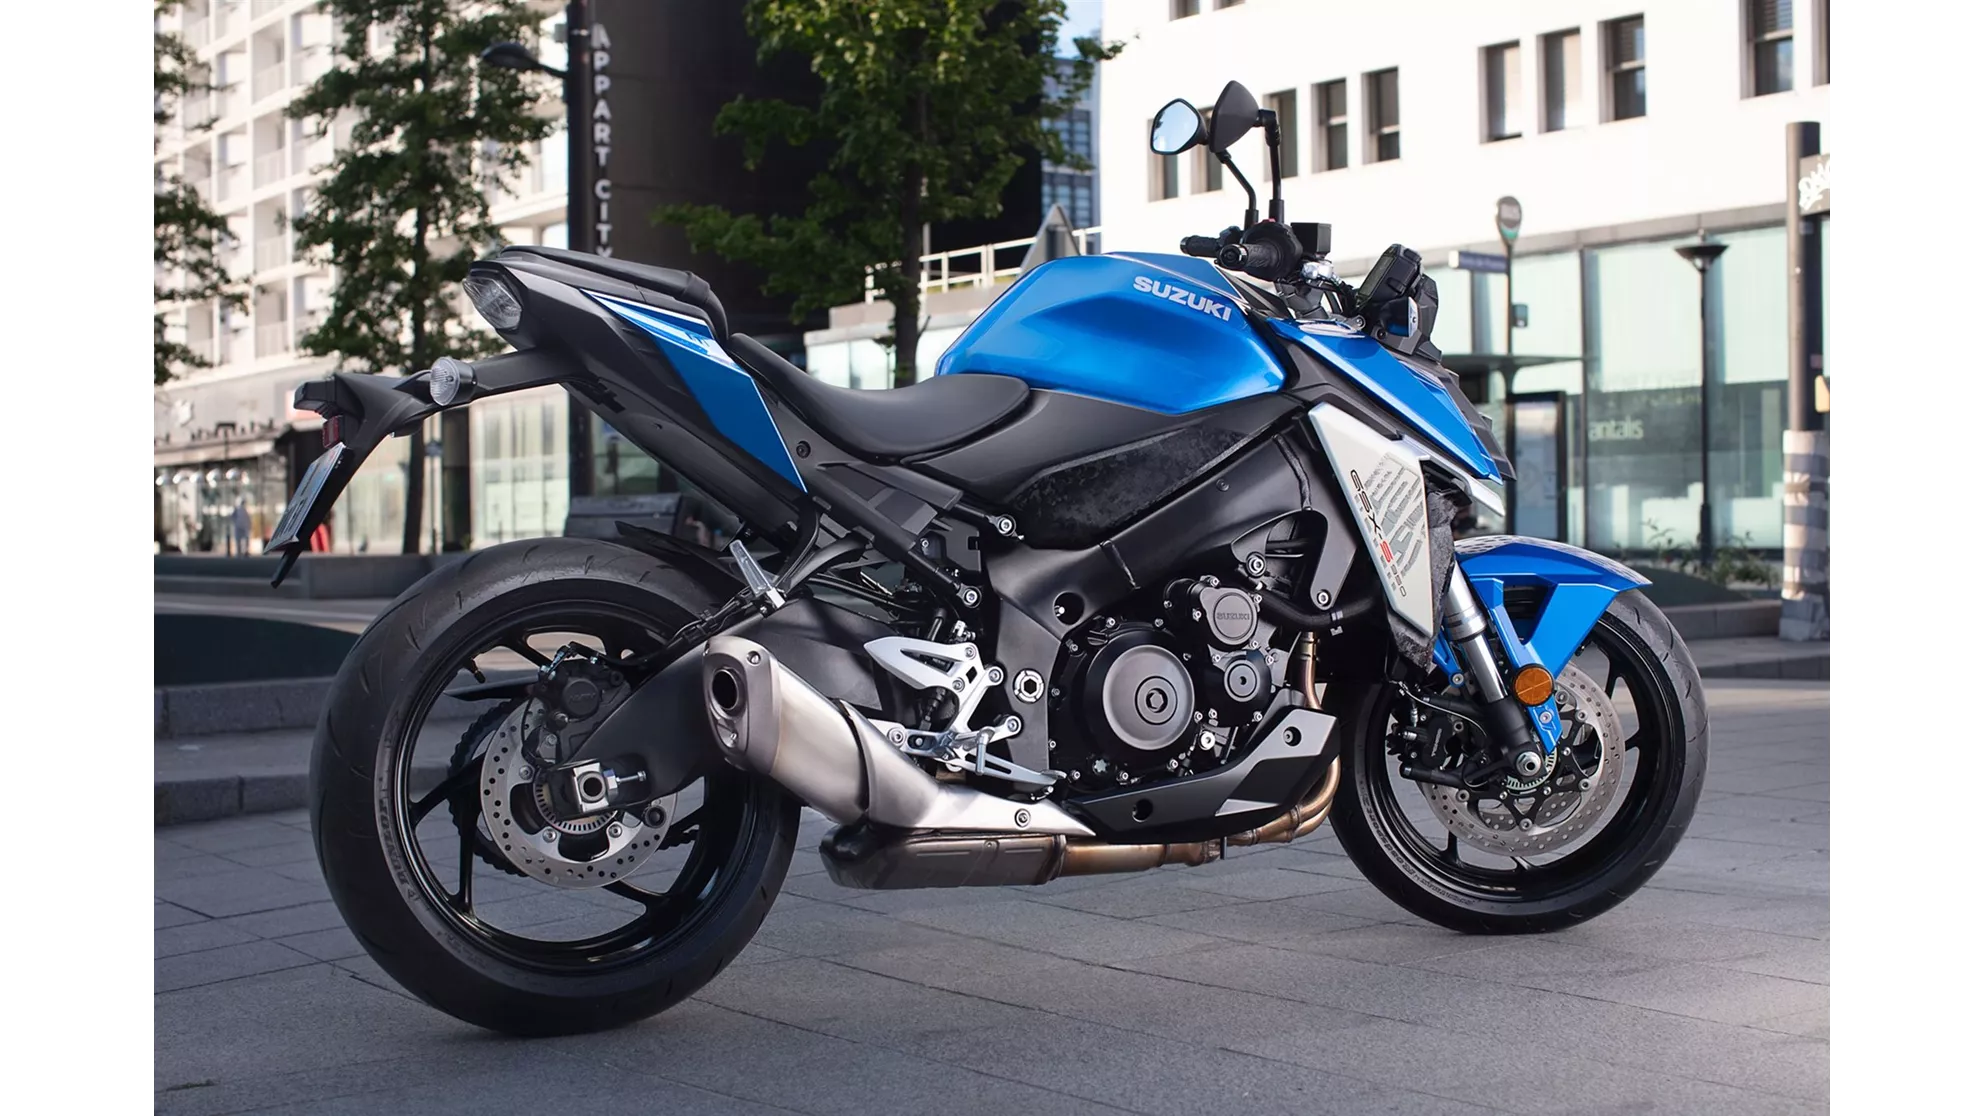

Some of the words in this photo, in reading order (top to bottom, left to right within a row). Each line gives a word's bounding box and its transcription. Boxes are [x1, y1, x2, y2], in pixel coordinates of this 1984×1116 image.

[591, 23, 612, 167] APPART
[1132, 275, 1233, 322] SUZUKI
[1216, 612, 1250, 620] SUZUKI
